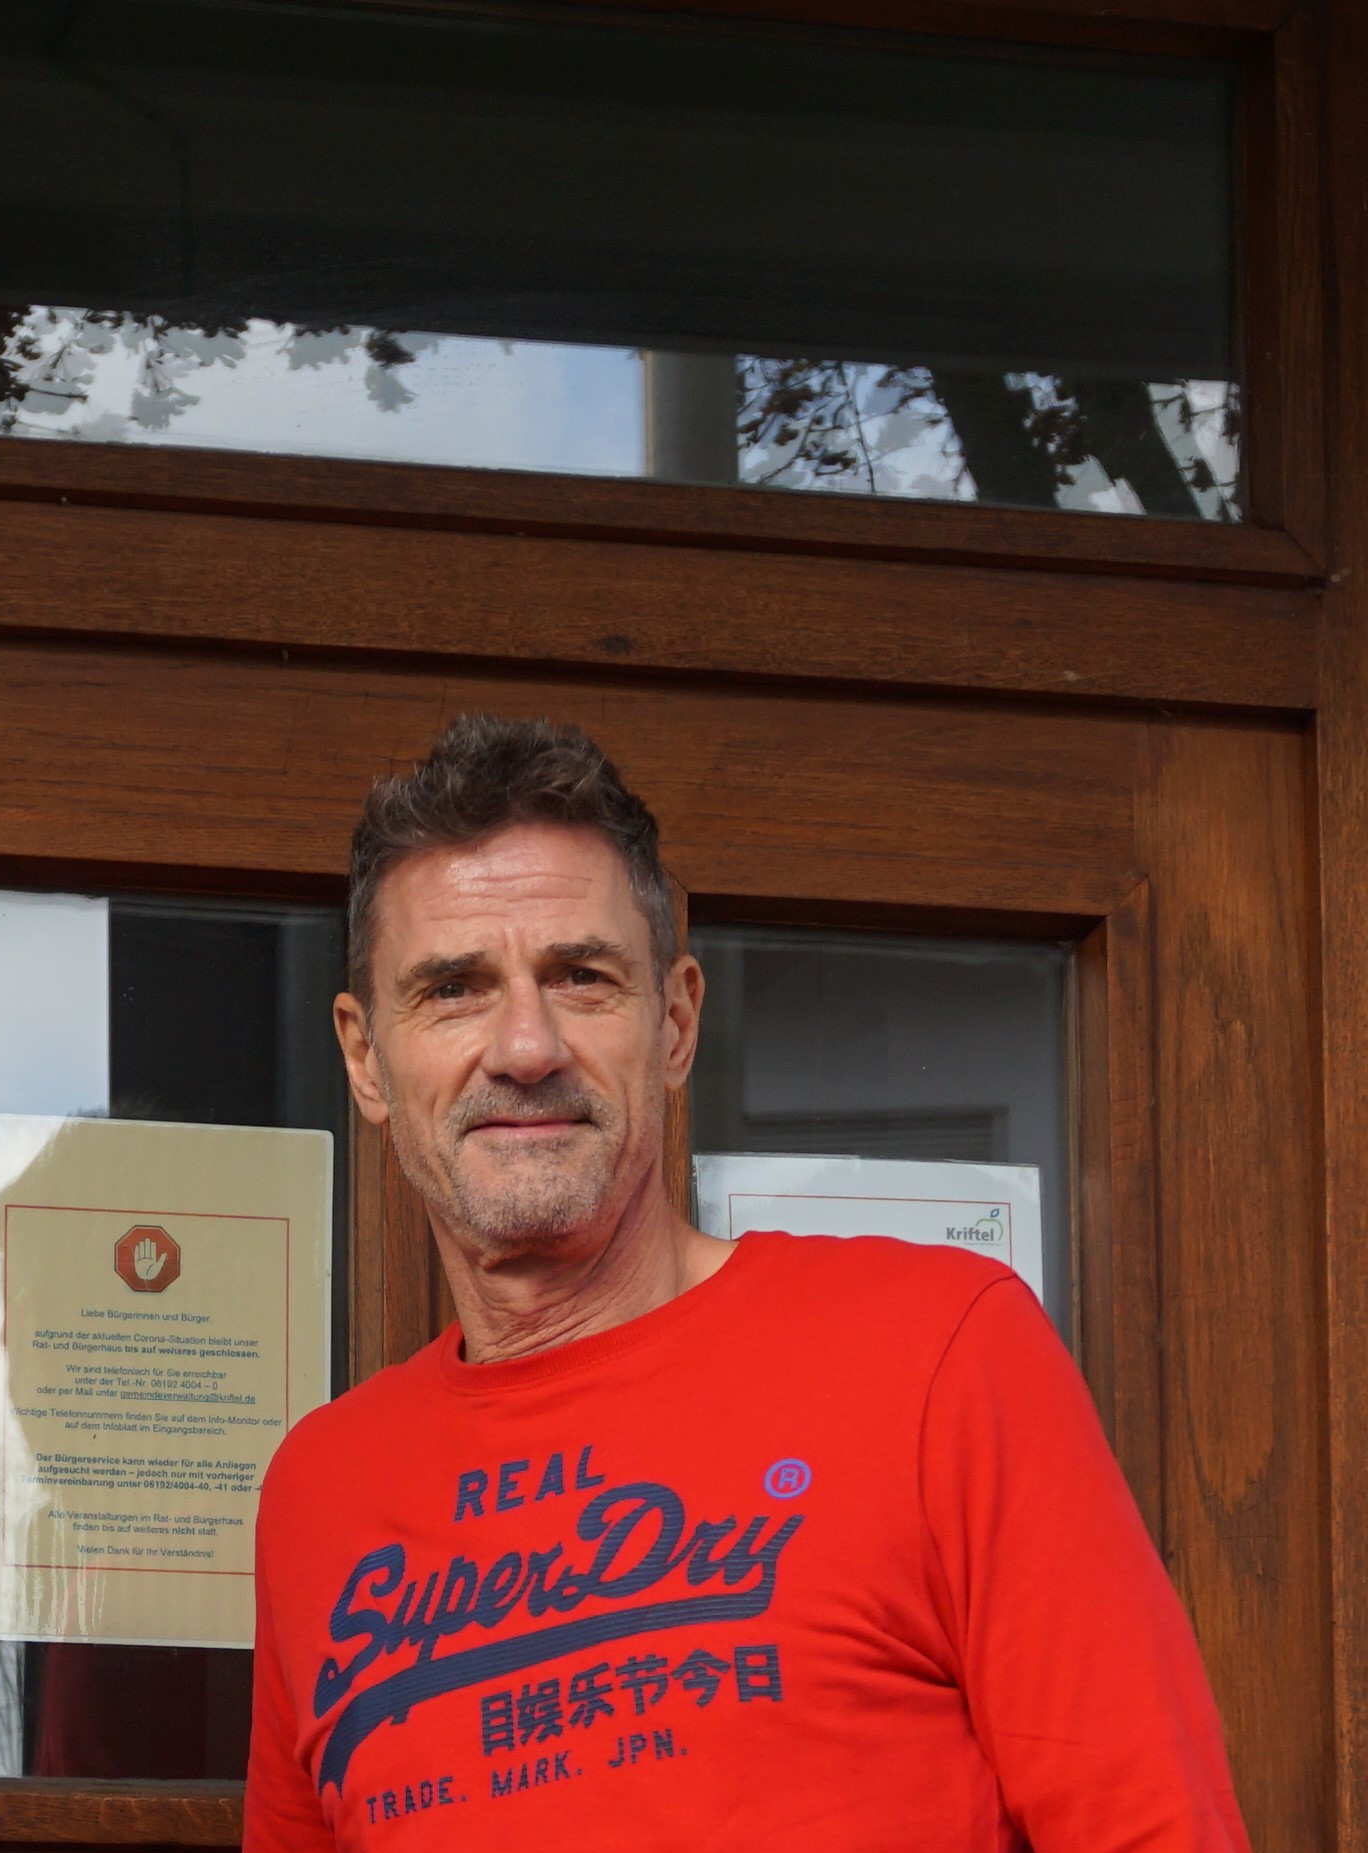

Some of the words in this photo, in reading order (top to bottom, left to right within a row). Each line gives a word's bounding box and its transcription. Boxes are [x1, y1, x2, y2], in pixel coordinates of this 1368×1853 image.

[946, 1227, 994, 1241] Kriftel
[81, 1309, 104, 1317] Liebe
[108, 1310, 159, 1320] Bürgerinnen
[163, 1313, 178, 1321] und
[35, 1330, 73, 1339] aufgrund
[92, 1333, 131, 1341] aktuellen
[134, 1334, 206, 1344] Corona-Situation
[209, 1337, 232, 1345] bleibt
[33, 1340, 51, 1348] Rat-
[54, 1342, 69, 1350] und
[72, 1342, 122, 1352] Bürgerhaus
[125, 1344, 138, 1352] bis
[159, 1347, 196, 1355] weiteres
[200, 1349, 260, 1358] geschlossen.
[84, 1365, 101, 1373] sind
[104, 1365, 150, 1376] telefonisch
[153, 1368, 163, 1376] für
[167, 1369, 180, 1377] Sie
[183, 1371, 226, 1379] erreichbar
[75, 1377, 97, 1385] unter
[37, 1386, 56, 1394] oder
[59, 1388, 72, 1396] per
[50, 1408, 123, 1419] Telefonnummern
[126, 1412, 152, 1421] finden
[171, 1414, 184, 1422] auf
[209, 1416, 260, 1425] Info-Monitor
[263, 1418, 282, 1426] oder
[81, 1422, 100, 1430] dem
[103, 1423, 137, 1431] Infoblatt
[153, 1424, 226, 1435] Eingangsbereich.
[36, 1453, 52, 1461] Der
[55, 1454, 120, 1464] Bürgerservice
[123, 1457, 144, 1465] kann
[148, 1459, 179, 1467] wieder
[182, 1459, 194, 1467] für
[197, 1460, 212, 1468] alle
[215, 1461, 256, 1470] Anliegen
[38, 1465, 89, 1475] aufgesucht
[93, 1467, 126, 1476] werden
[136, 1470, 168, 1478] jedoch
[189, 1471, 203, 1479] mit
[207, 1472, 254, 1482] vorheriger
[118, 1480, 142, 1488] unter
[231, 1483, 252, 1492] oder
[453, 1445, 606, 1521] REAL
[67, 1511, 138, 1522] Veranstaltungen
[154, 1514, 172, 1522] Rat-
[73, 1523, 99, 1531] finden
[103, 1524, 115, 1532] bis
[133, 1525, 169, 1534] weiteres
[172, 1527, 195, 1535] nicht
[77, 1545, 104, 1553] Vielen
[108, 1546, 129, 1554] Dank
[132, 1547, 144, 1555] für
[366, 1777, 467, 1823] TRADE.
[491, 1752, 582, 1796] MARK.
[609, 1730, 688, 1768] JPN.
